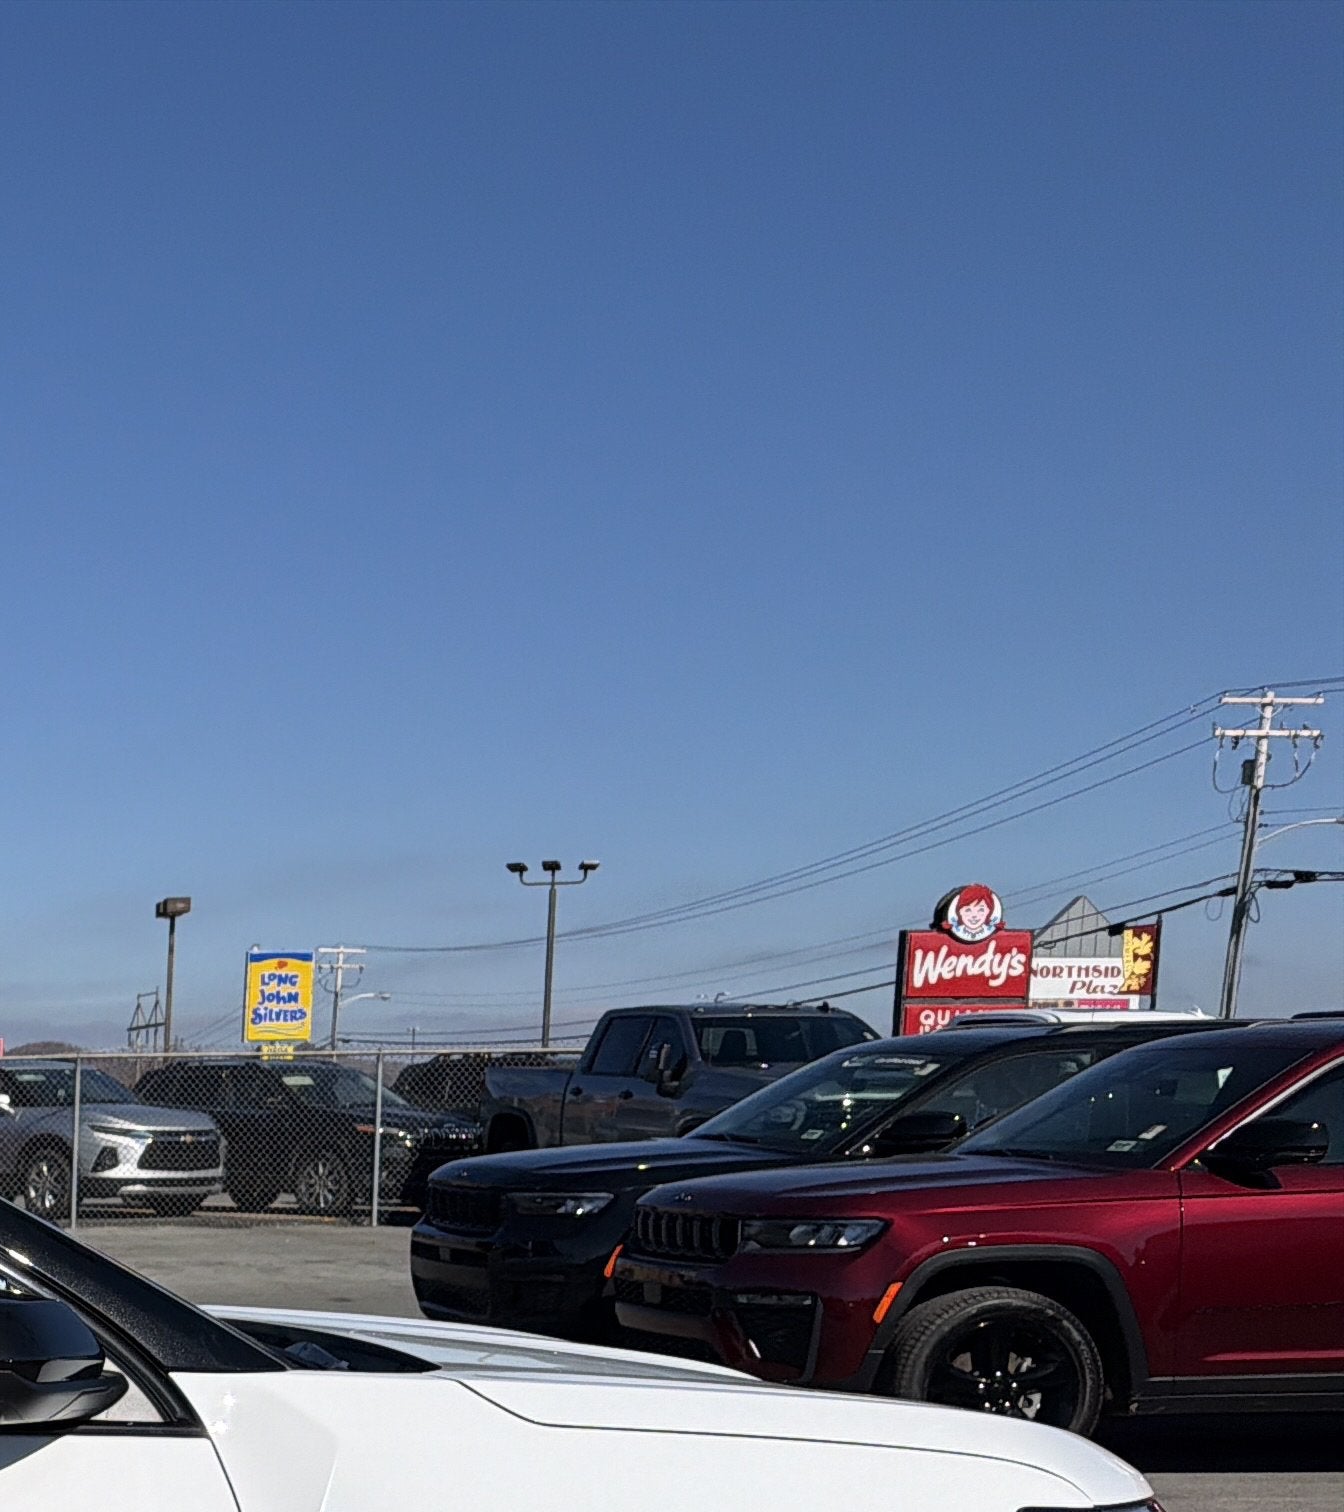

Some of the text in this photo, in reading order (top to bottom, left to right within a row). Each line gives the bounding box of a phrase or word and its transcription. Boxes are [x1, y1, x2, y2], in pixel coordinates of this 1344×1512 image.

[913, 940, 1026, 988] Wendy's
[1031, 963, 1122, 979] NORTHSID
[1069, 980, 1119, 995] Plaz
